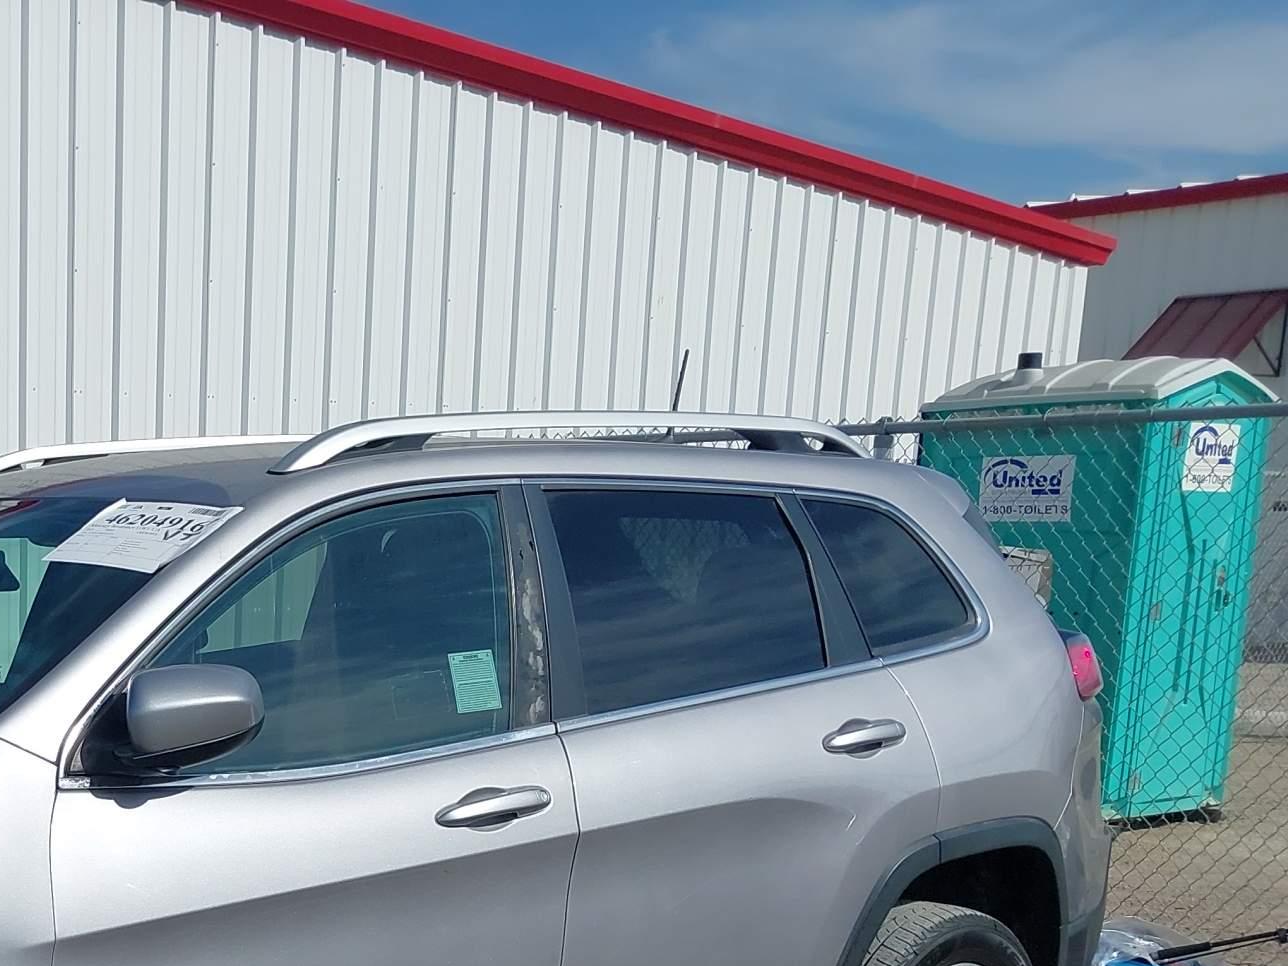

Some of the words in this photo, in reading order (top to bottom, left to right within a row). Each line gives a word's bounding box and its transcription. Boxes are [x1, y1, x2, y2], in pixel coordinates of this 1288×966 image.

[1194, 437, 1235, 457] United
[992, 469, 1063, 488] United
[983, 504, 1069, 515] 1-800-TOILETS
[105, 513, 210, 533] 46204916
